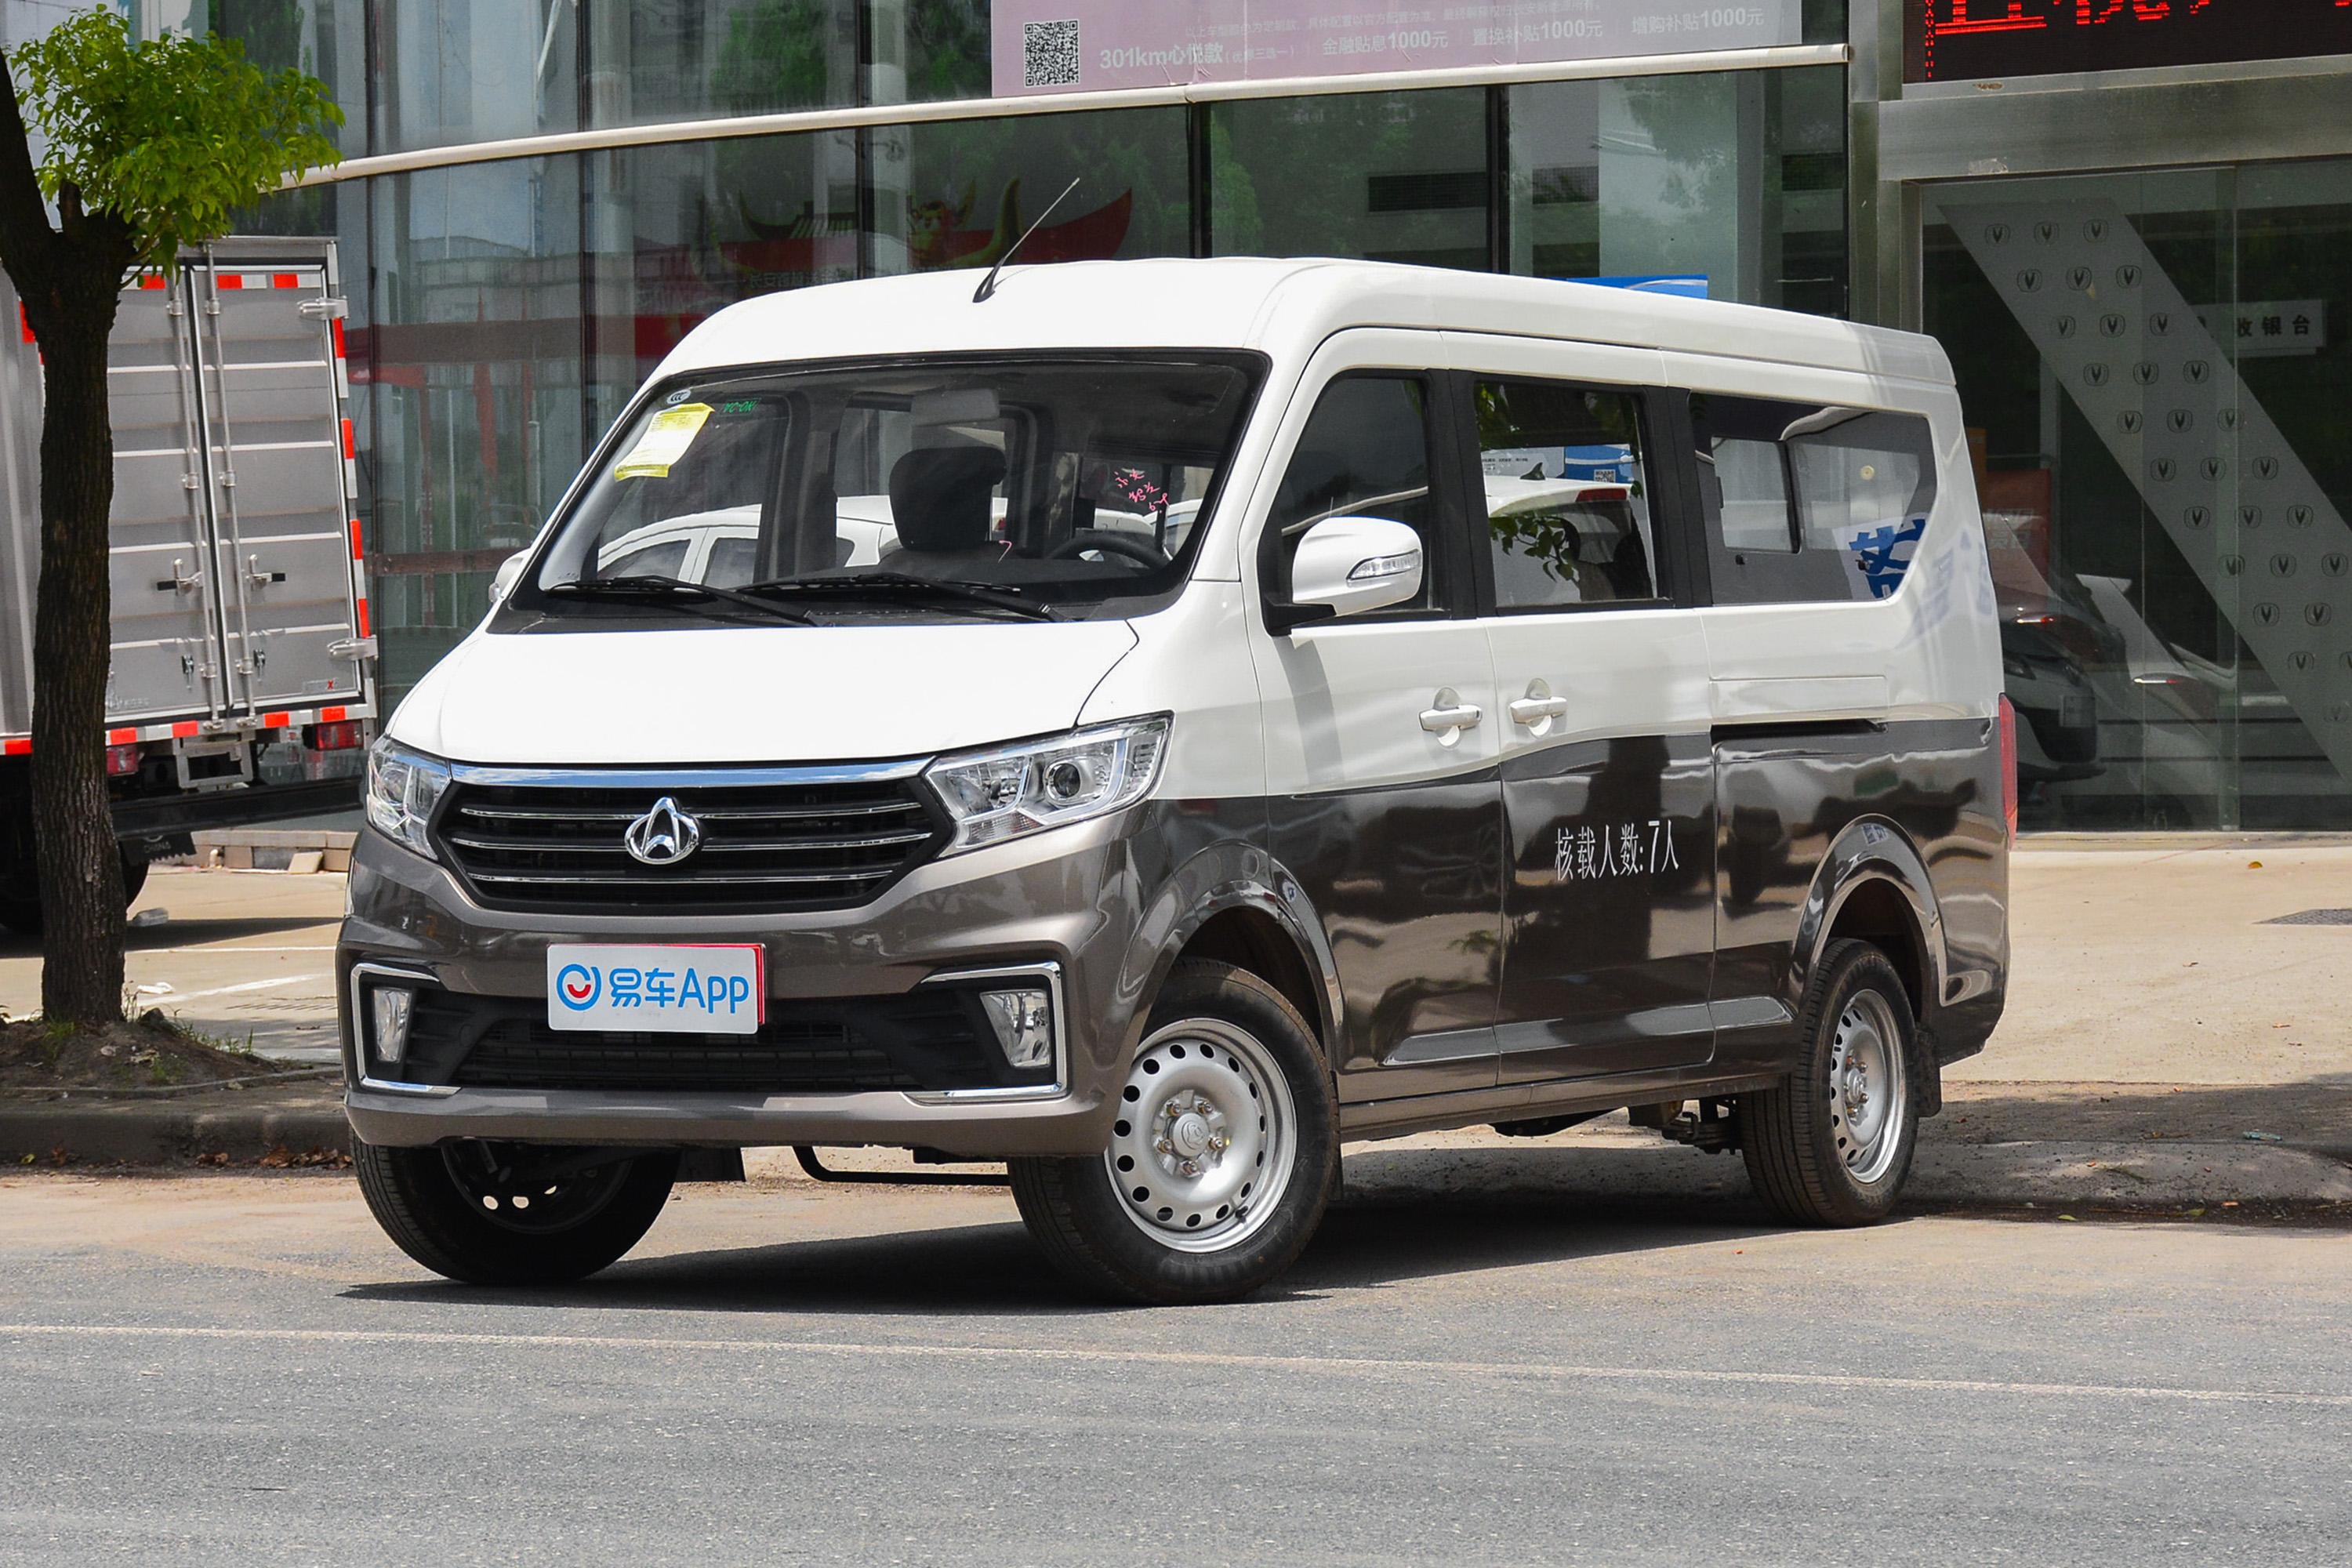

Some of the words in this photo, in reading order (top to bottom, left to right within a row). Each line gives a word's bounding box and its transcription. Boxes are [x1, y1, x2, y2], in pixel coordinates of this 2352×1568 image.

[1472, 19, 1603, 46] 置换补贴1000元
[1632, 8, 1764, 35] 增购补贴1000元
[1322, 30, 1448, 55] 金融贴息1000元
[2237, 314, 2310, 337] 收银台
[1555, 819, 1679, 881] 核载人数:7人
[608, 967, 750, 1014] 易车App
